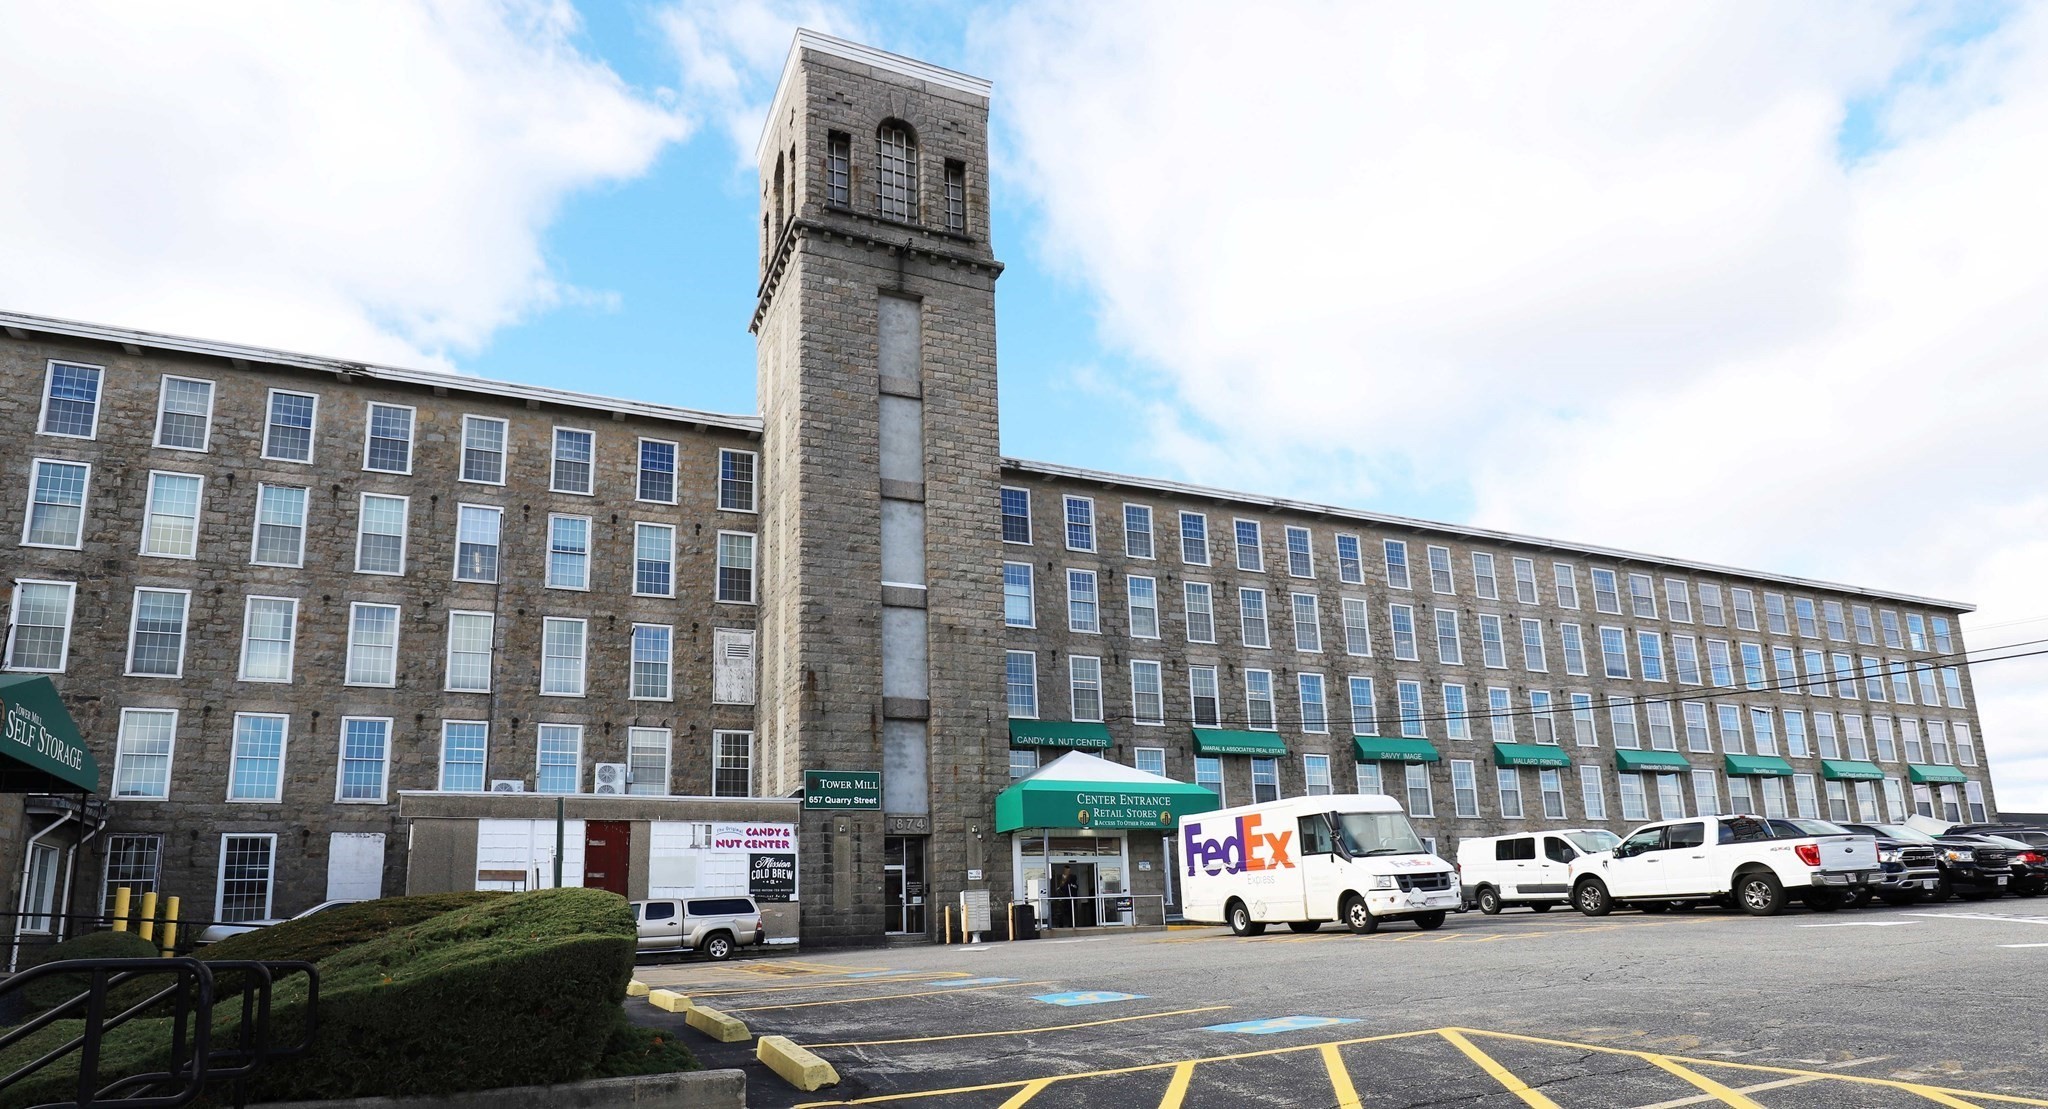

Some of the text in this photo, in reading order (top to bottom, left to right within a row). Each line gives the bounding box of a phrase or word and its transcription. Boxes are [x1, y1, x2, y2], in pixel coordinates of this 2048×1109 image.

[16, 702, 43, 727] TOWER MILL
[6, 709, 83, 771] SELF STORAGE
[1017, 736, 1107, 747] CANDY & NUT CENTER
[820, 779, 878, 789] TOWER MILL
[808, 796, 877, 806] 657 Quarry Street
[1076, 793, 1171, 806] CENTER ENTRANCE
[1093, 807, 1157, 818] RETAIL STORES
[746, 827, 790, 837] CANDY &
[715, 839, 790, 849] NUT CENTER
[1184, 813, 1296, 876] FedEx
[755, 856, 792, 869] Mission
[751, 868, 794, 880] COLD BREW
[1247, 874, 1275, 885] Express
